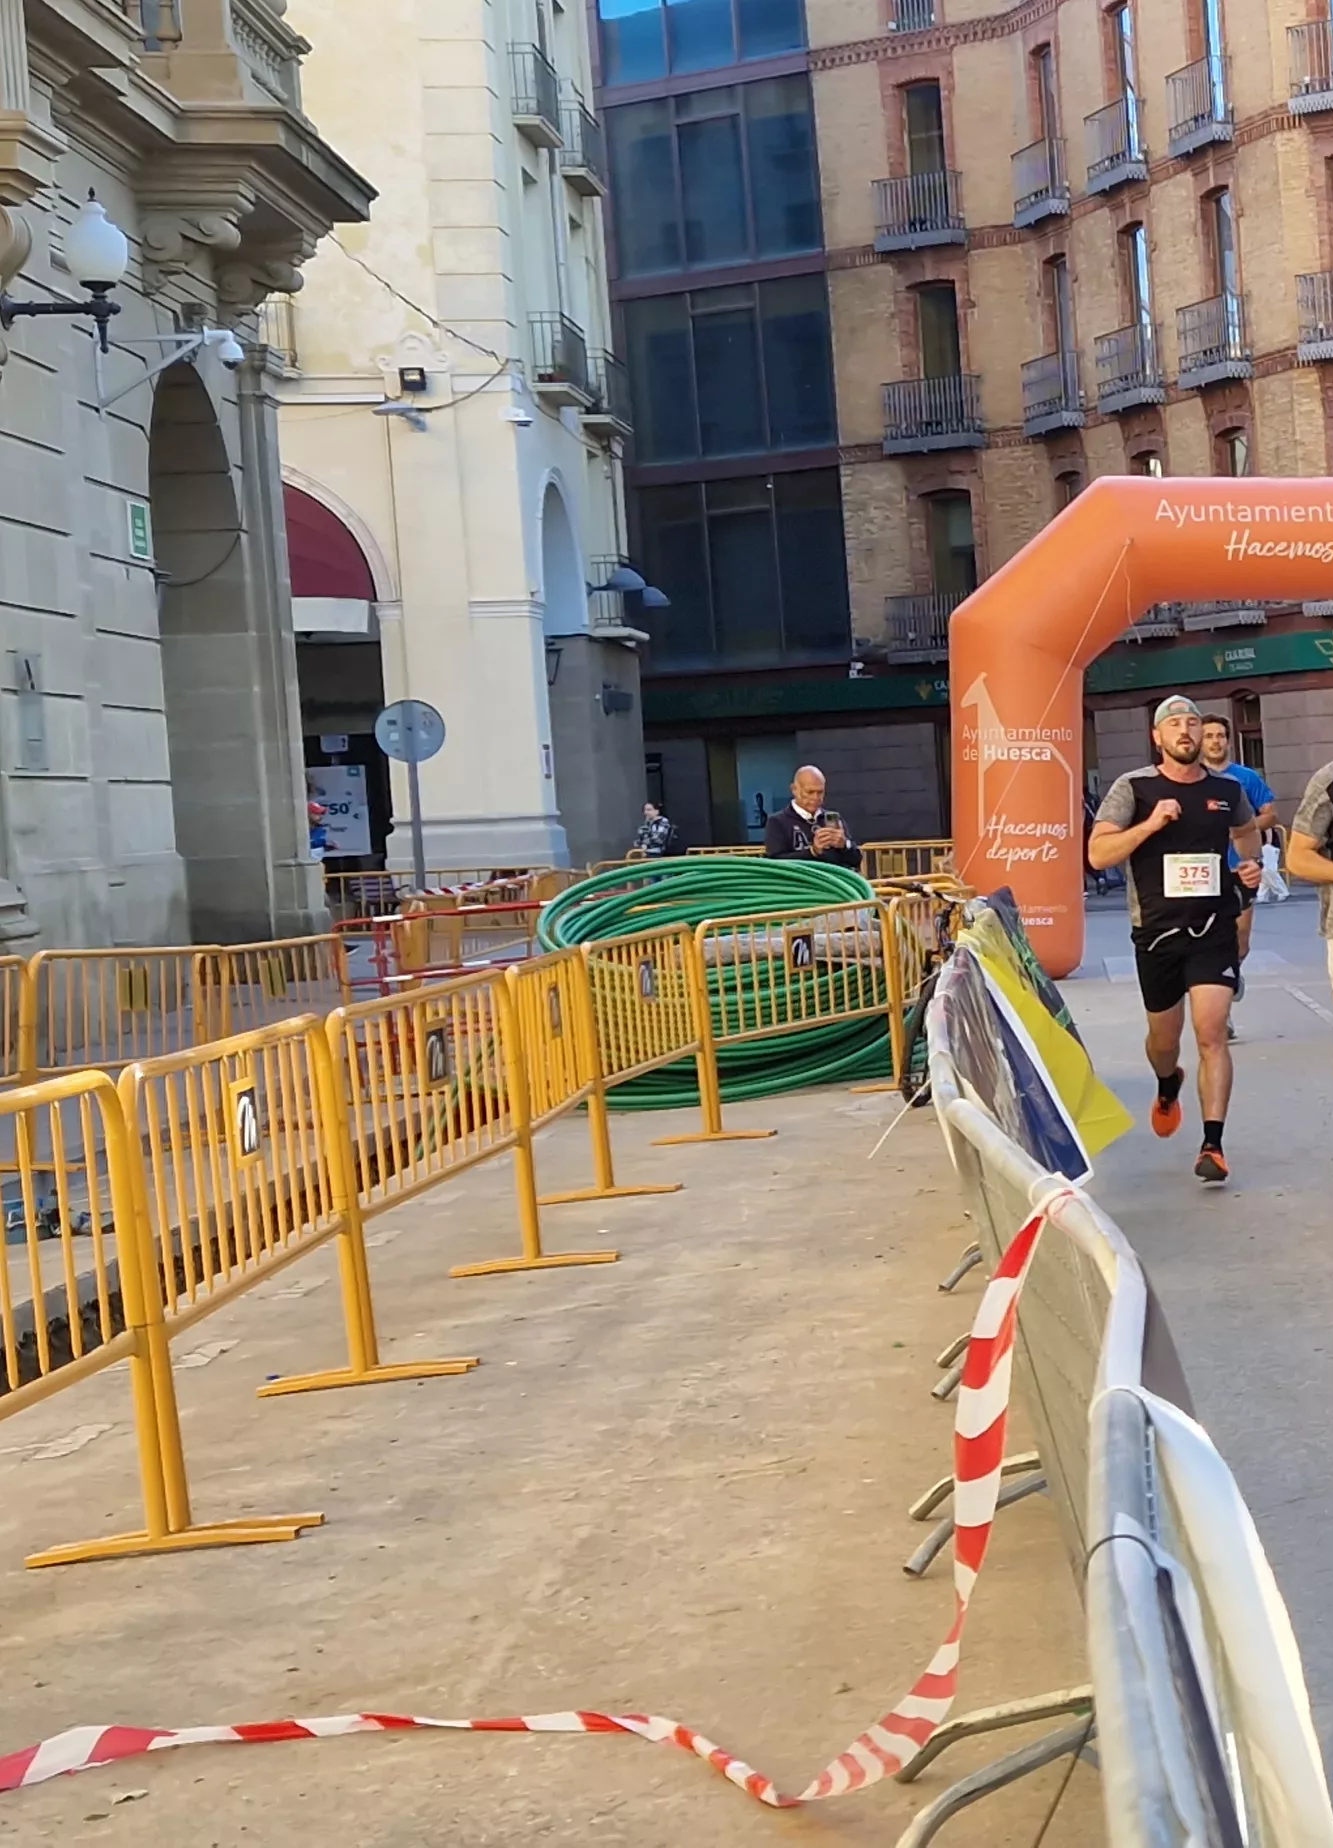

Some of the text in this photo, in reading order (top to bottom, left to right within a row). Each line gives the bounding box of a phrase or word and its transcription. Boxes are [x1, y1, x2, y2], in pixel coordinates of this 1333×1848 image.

[961, 725, 1073, 745] Ayuntamiento
[962, 745, 1051, 761] de Huesca
[984, 814, 1068, 841] Hacemos
[986, 843, 1059, 871] deporte
[1179, 866, 1210, 879] 375
[1021, 917, 1054, 926] uesca
